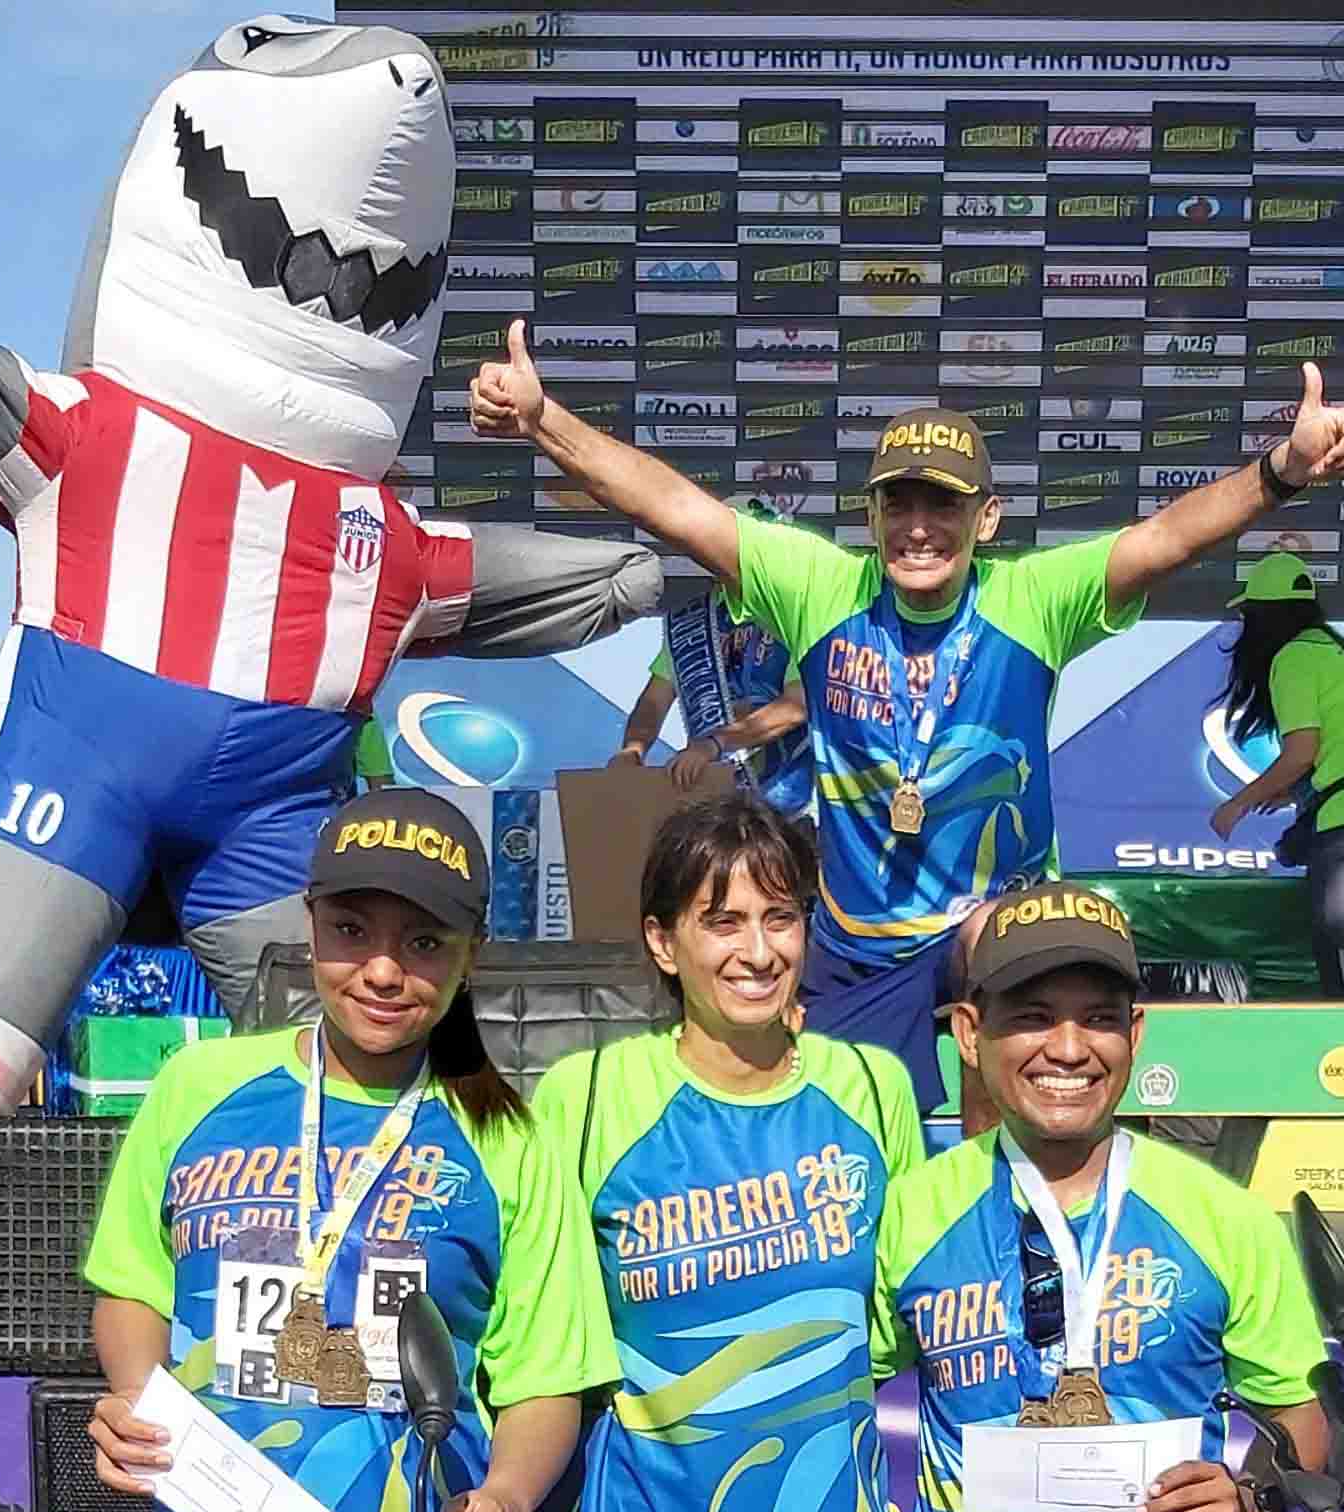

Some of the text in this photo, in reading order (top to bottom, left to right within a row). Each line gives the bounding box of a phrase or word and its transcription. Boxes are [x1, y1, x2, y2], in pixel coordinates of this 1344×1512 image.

[638, 48, 673, 68] UN
[682, 49, 745, 68] RETO
[754, 50, 824, 69] PARA
[869, 51, 905, 70] UN
[913, 52, 1004, 70] HONOR
[1013, 53, 1083, 71] PARA
[1091, 54, 1231, 72] NOSOTROS
[879, 422, 975, 459] POLICIA
[1057, 433, 1121, 449] CUL
[343, 526, 379, 541] JUNIOR
[334, 818, 472, 881] POLICIA
[996, 893, 1130, 940] POLICIA
[609, 1143, 852, 1257] CARRERA 20
[619, 1202, 853, 1303] POR LA POLICÍA 19
[960, 1350, 987, 1387] LA
[1096, 1308, 1142, 1368] 19
